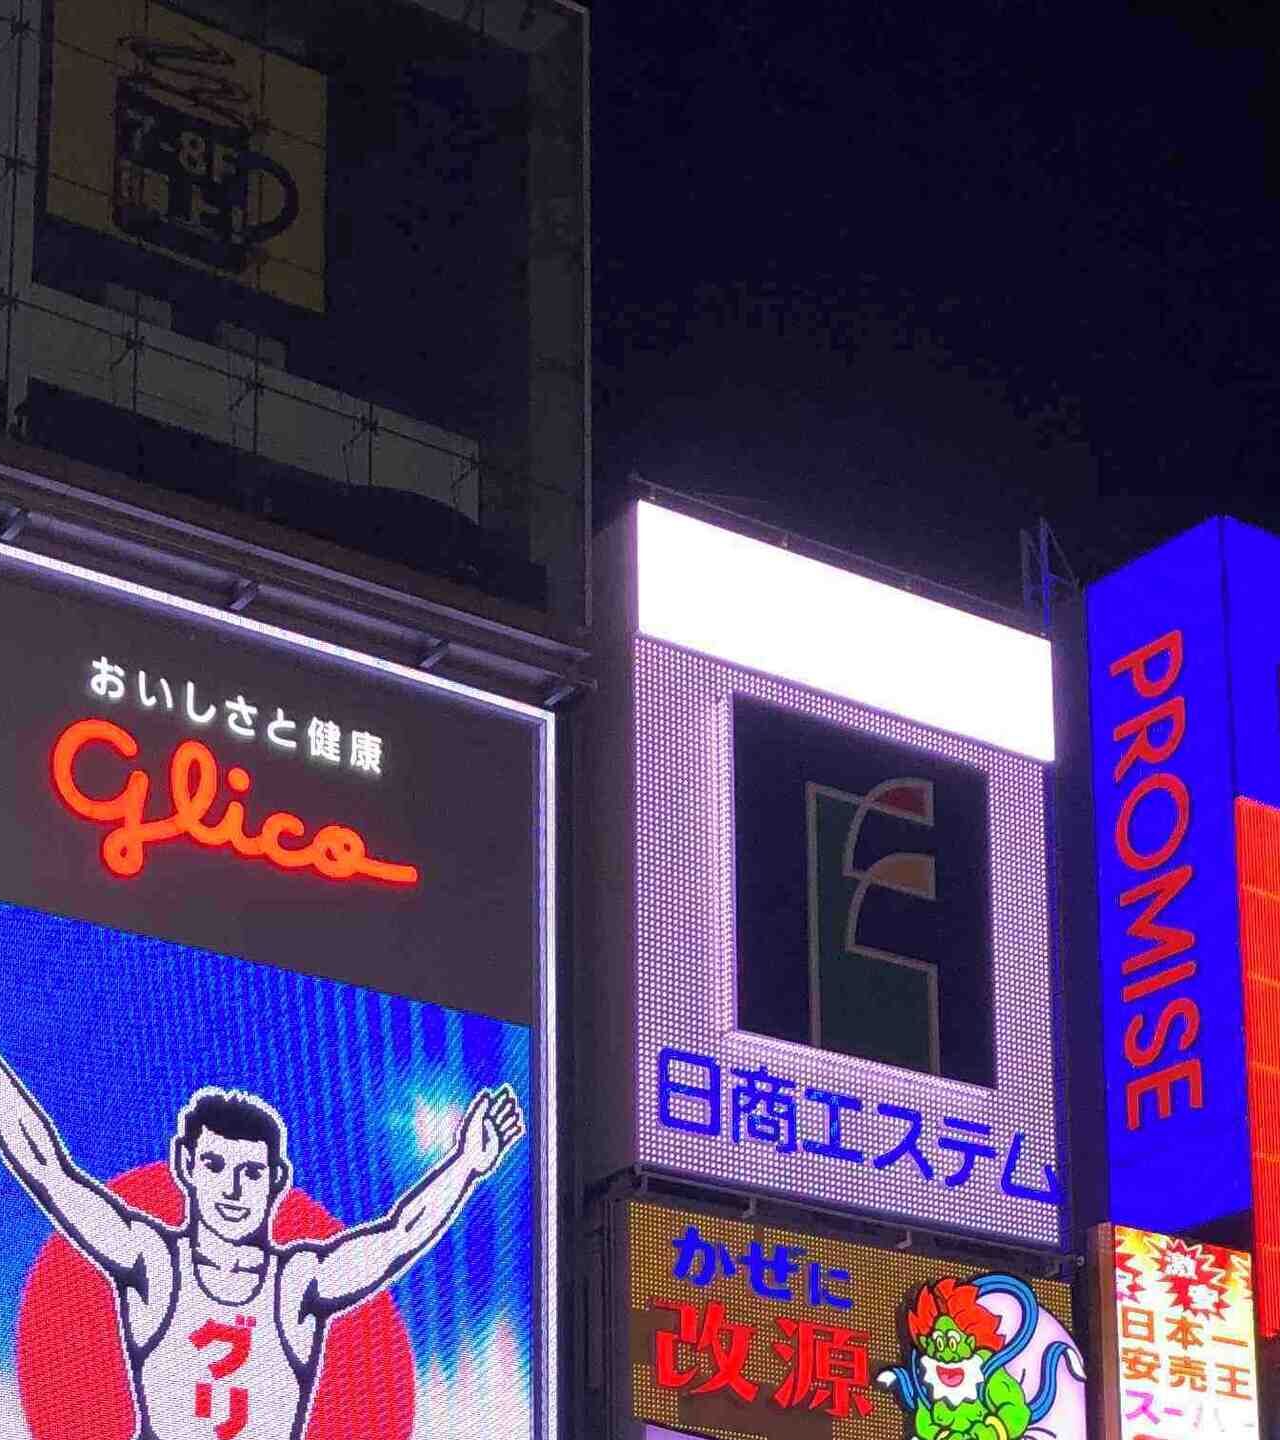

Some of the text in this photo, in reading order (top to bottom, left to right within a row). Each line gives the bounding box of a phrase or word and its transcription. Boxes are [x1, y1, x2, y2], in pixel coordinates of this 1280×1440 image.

[90, 656, 383, 774] おいしさと健康
[53, 719, 418, 875] Glico
[1110, 630, 1202, 1131] PROMISE
[658, 1047, 1063, 1203] 日商エステム
[672, 1225, 853, 1312] かぜに
[655, 1301, 873, 1418] 改源
[1121, 1347, 1252, 1400] 安売王
[1122, 1308, 1249, 1350] 日本一
